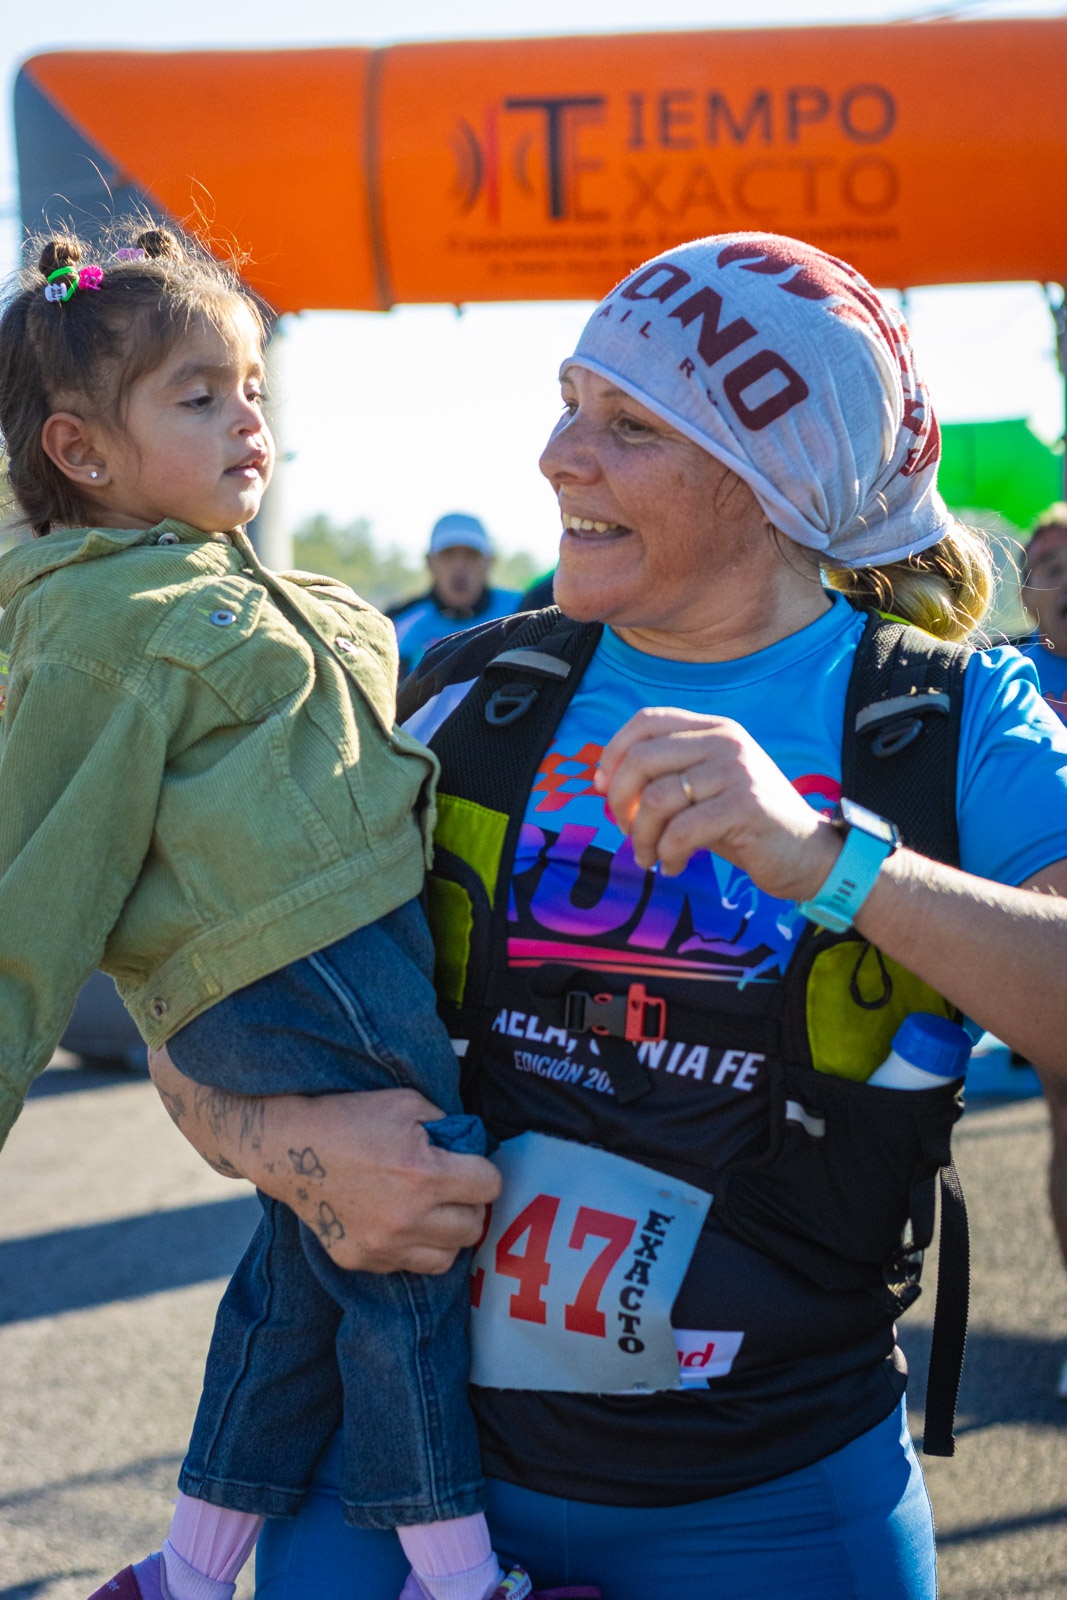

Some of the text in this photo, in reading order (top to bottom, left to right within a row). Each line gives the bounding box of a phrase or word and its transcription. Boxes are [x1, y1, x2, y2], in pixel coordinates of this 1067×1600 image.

[513, 1050, 615, 1095] EDICIÓN 20
[712, 1049, 766, 1092] FE
[618, 1210, 675, 1354] EXACTO
